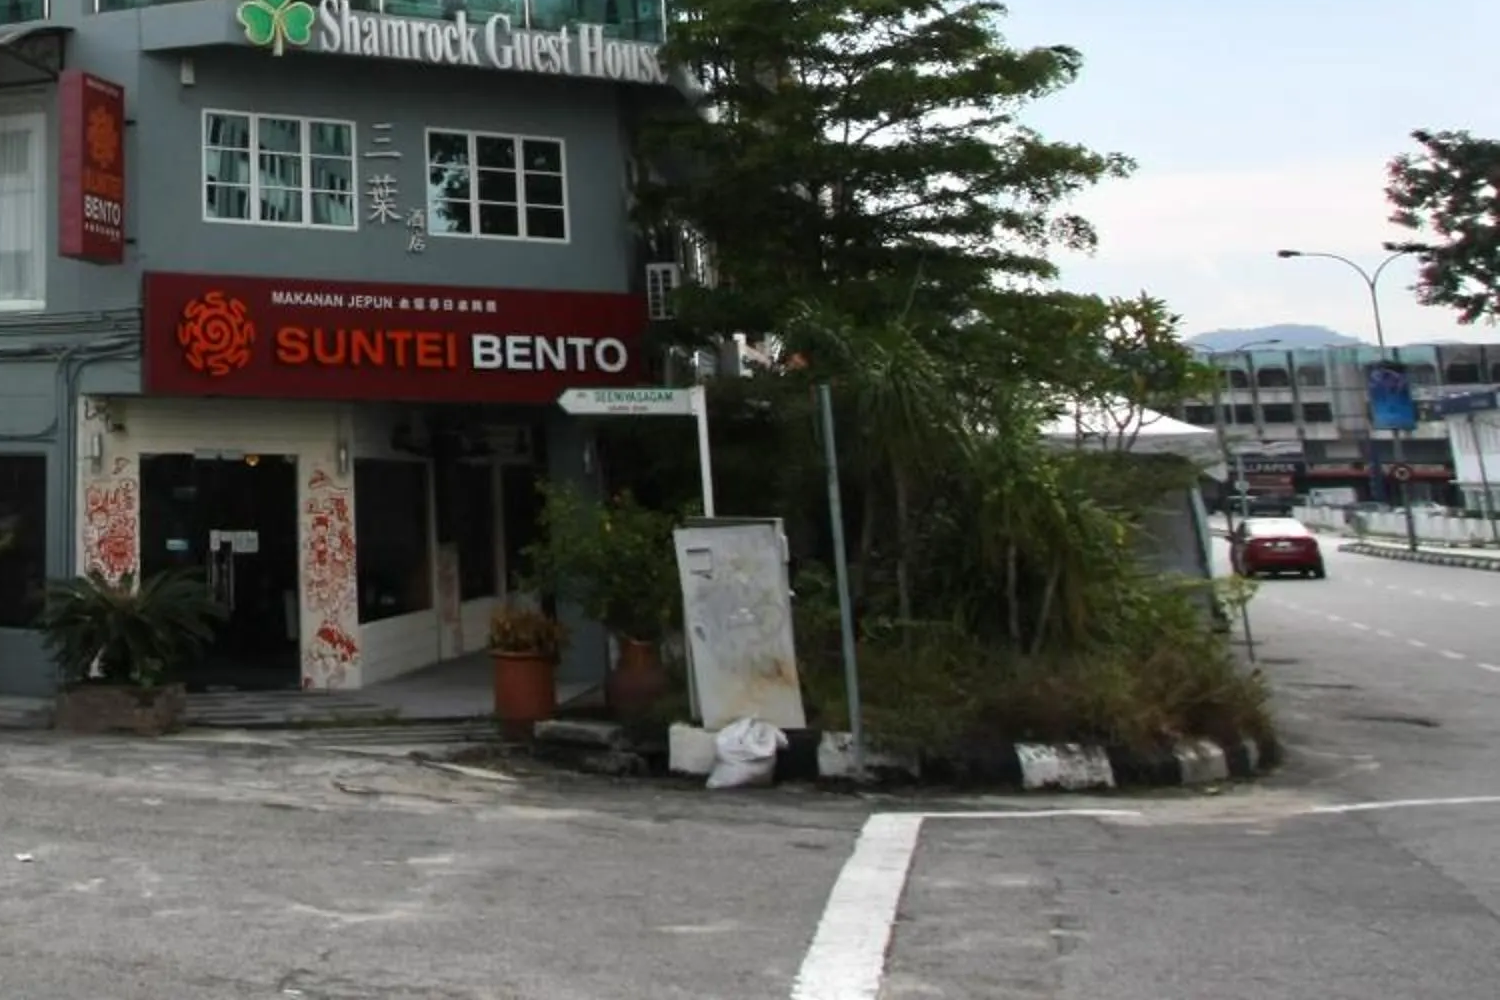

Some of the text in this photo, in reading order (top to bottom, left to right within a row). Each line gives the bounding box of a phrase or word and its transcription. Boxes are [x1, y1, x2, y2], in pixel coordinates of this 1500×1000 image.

[485, 13, 573, 75] Guest
[363, 122, 402, 225] 三葉
[84, 195, 121, 226] BENTO
[271, 290, 343, 309] MAKANAN
[347, 295, 393, 310] JEPUN
[276, 326, 629, 373] SUNTEI BENTO
